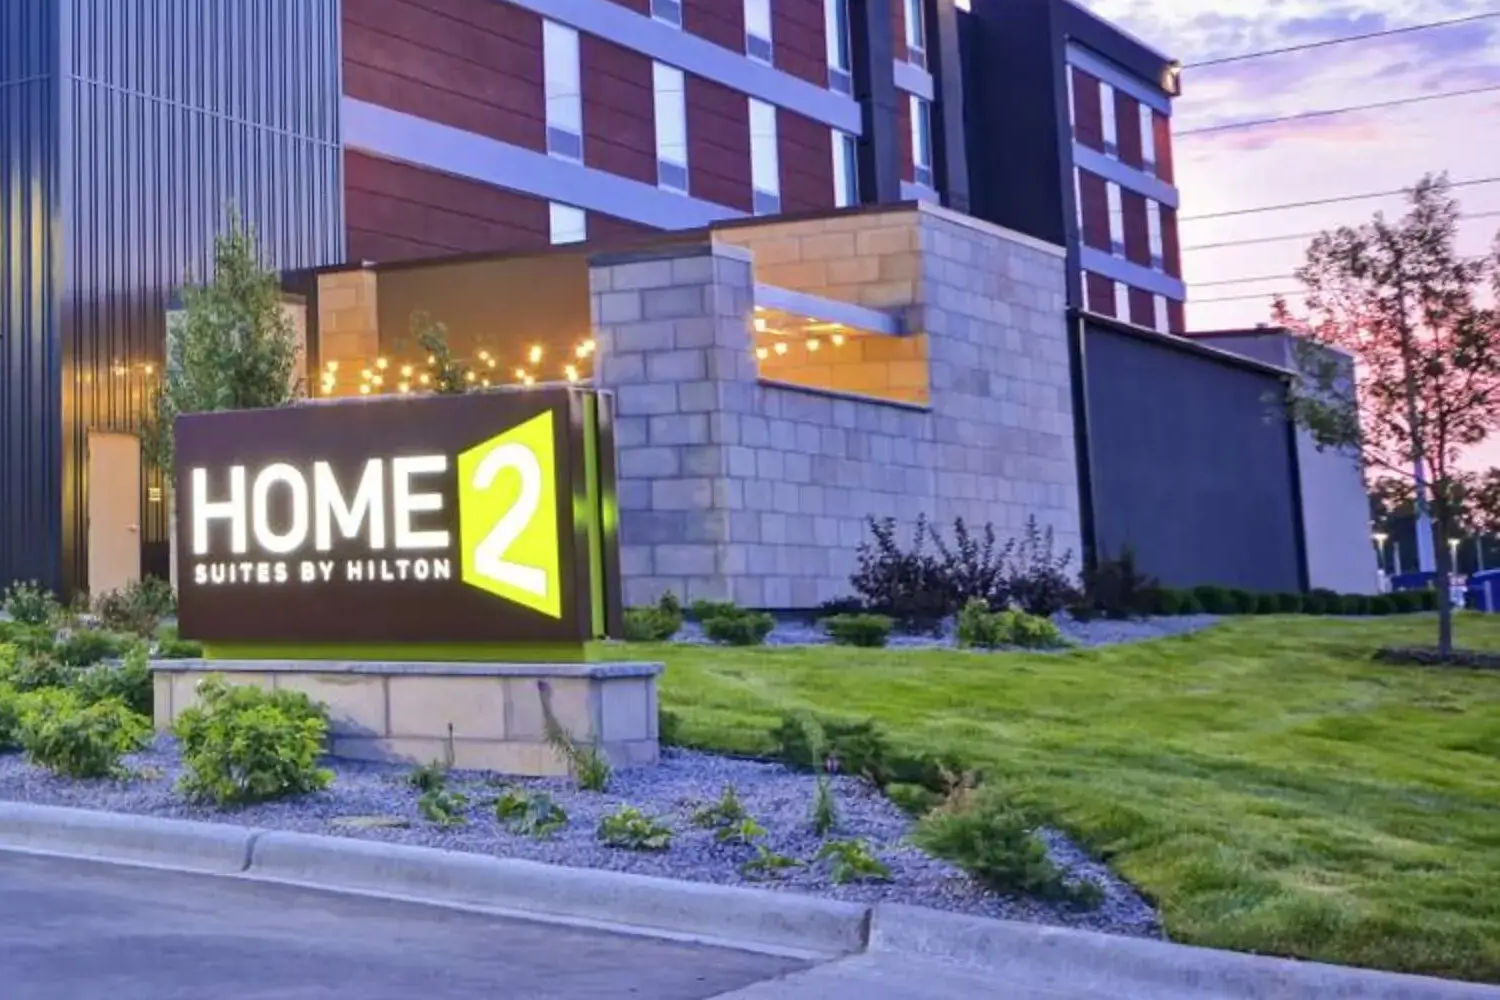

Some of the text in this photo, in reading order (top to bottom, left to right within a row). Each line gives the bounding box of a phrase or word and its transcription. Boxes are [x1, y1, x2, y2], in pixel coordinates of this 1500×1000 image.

[192, 441, 548, 598] HOME 2
[194, 559, 451, 585] SUITES BY HILTON
